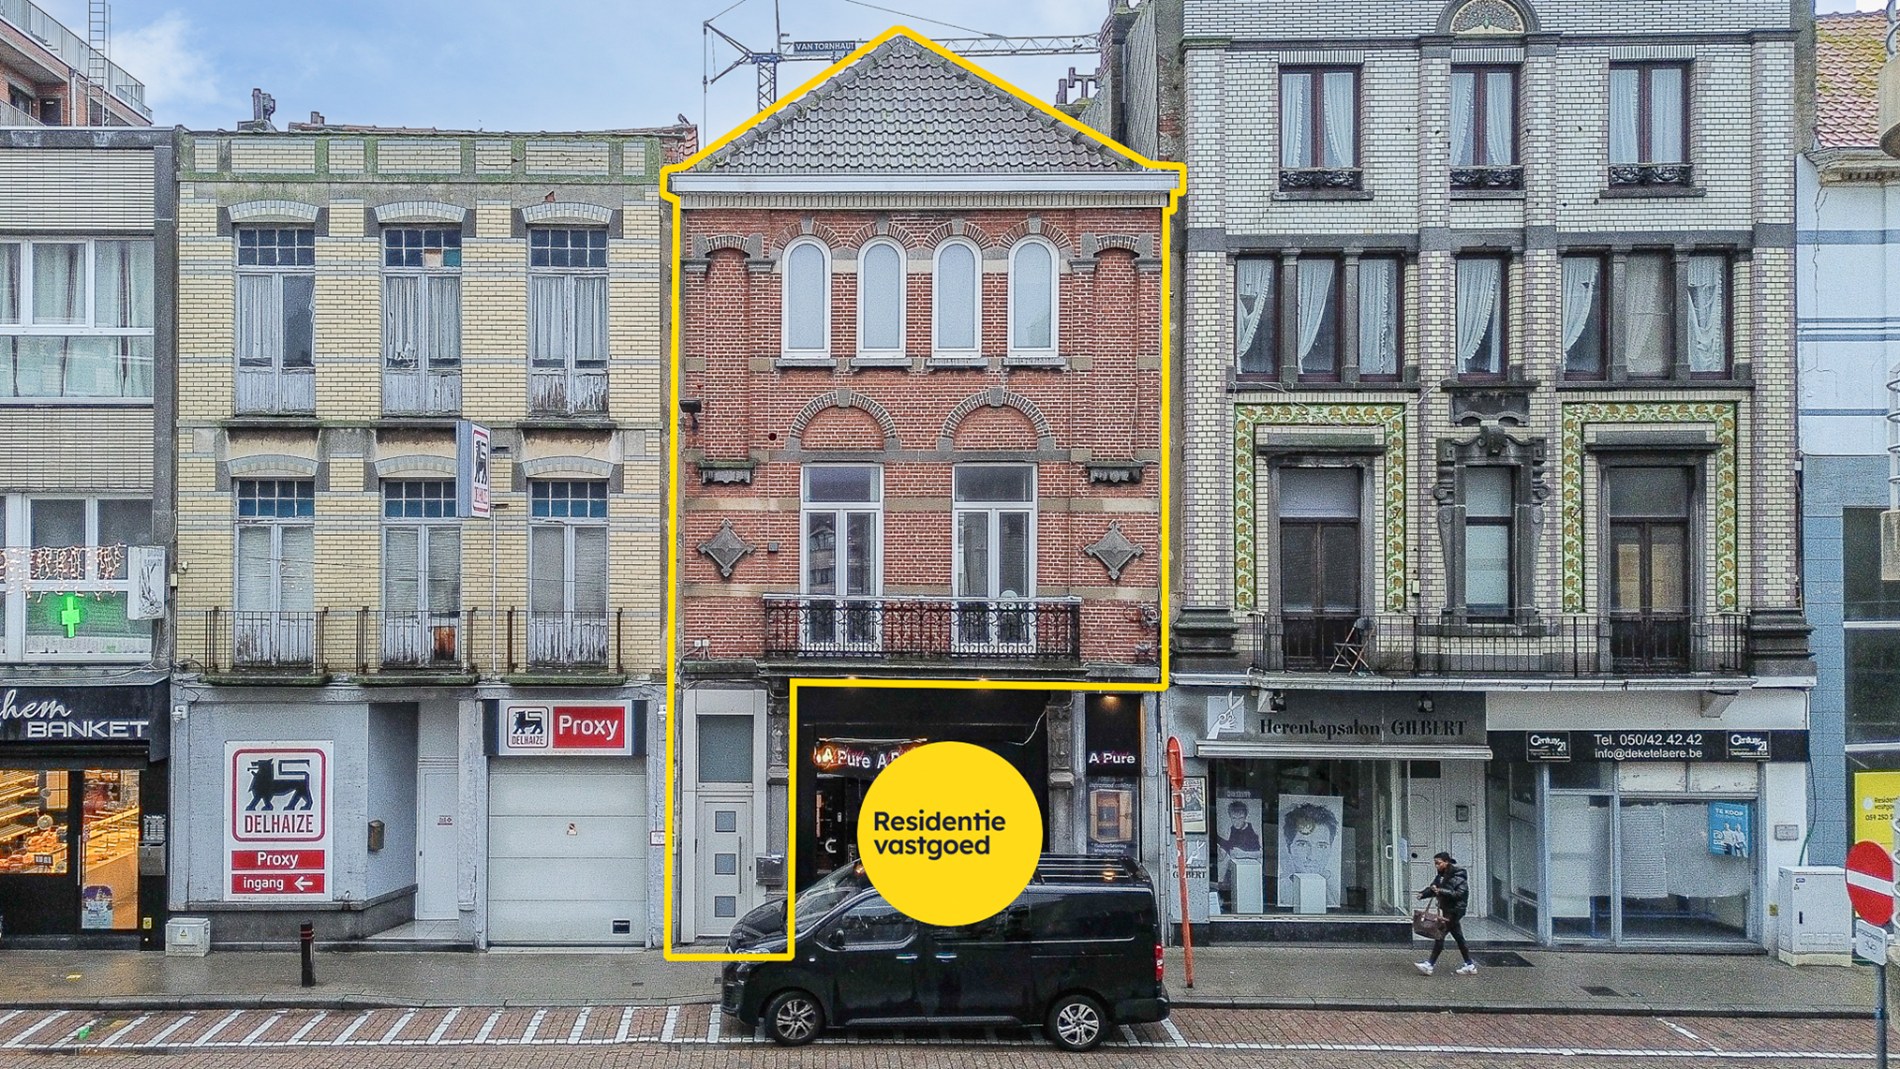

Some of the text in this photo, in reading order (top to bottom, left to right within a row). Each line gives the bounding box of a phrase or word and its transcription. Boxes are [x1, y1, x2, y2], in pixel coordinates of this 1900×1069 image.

[815, 42, 855, 50] TORNHAUT
[0, 689, 72, 720] hem
[27, 720, 149, 738] BANKET
[558, 715, 619, 741] Proxy
[1259, 718, 1467, 740] Herenkapsalon GILBERT
[511, 735, 544, 745] DELHAIZE
[1557, 741, 1567, 751] 21
[1594, 734, 1703, 746] Tel. 050/42.42.42
[1758, 741, 1767, 751] 21
[837, 750, 871, 768] Pure
[1088, 752, 1136, 764] A Pure
[1594, 748, 1703, 760] info@deketelaere.be
[244, 814, 314, 833] DELHAIZE
[257, 851, 299, 869] Proxy
[243, 876, 284, 891] ingang
